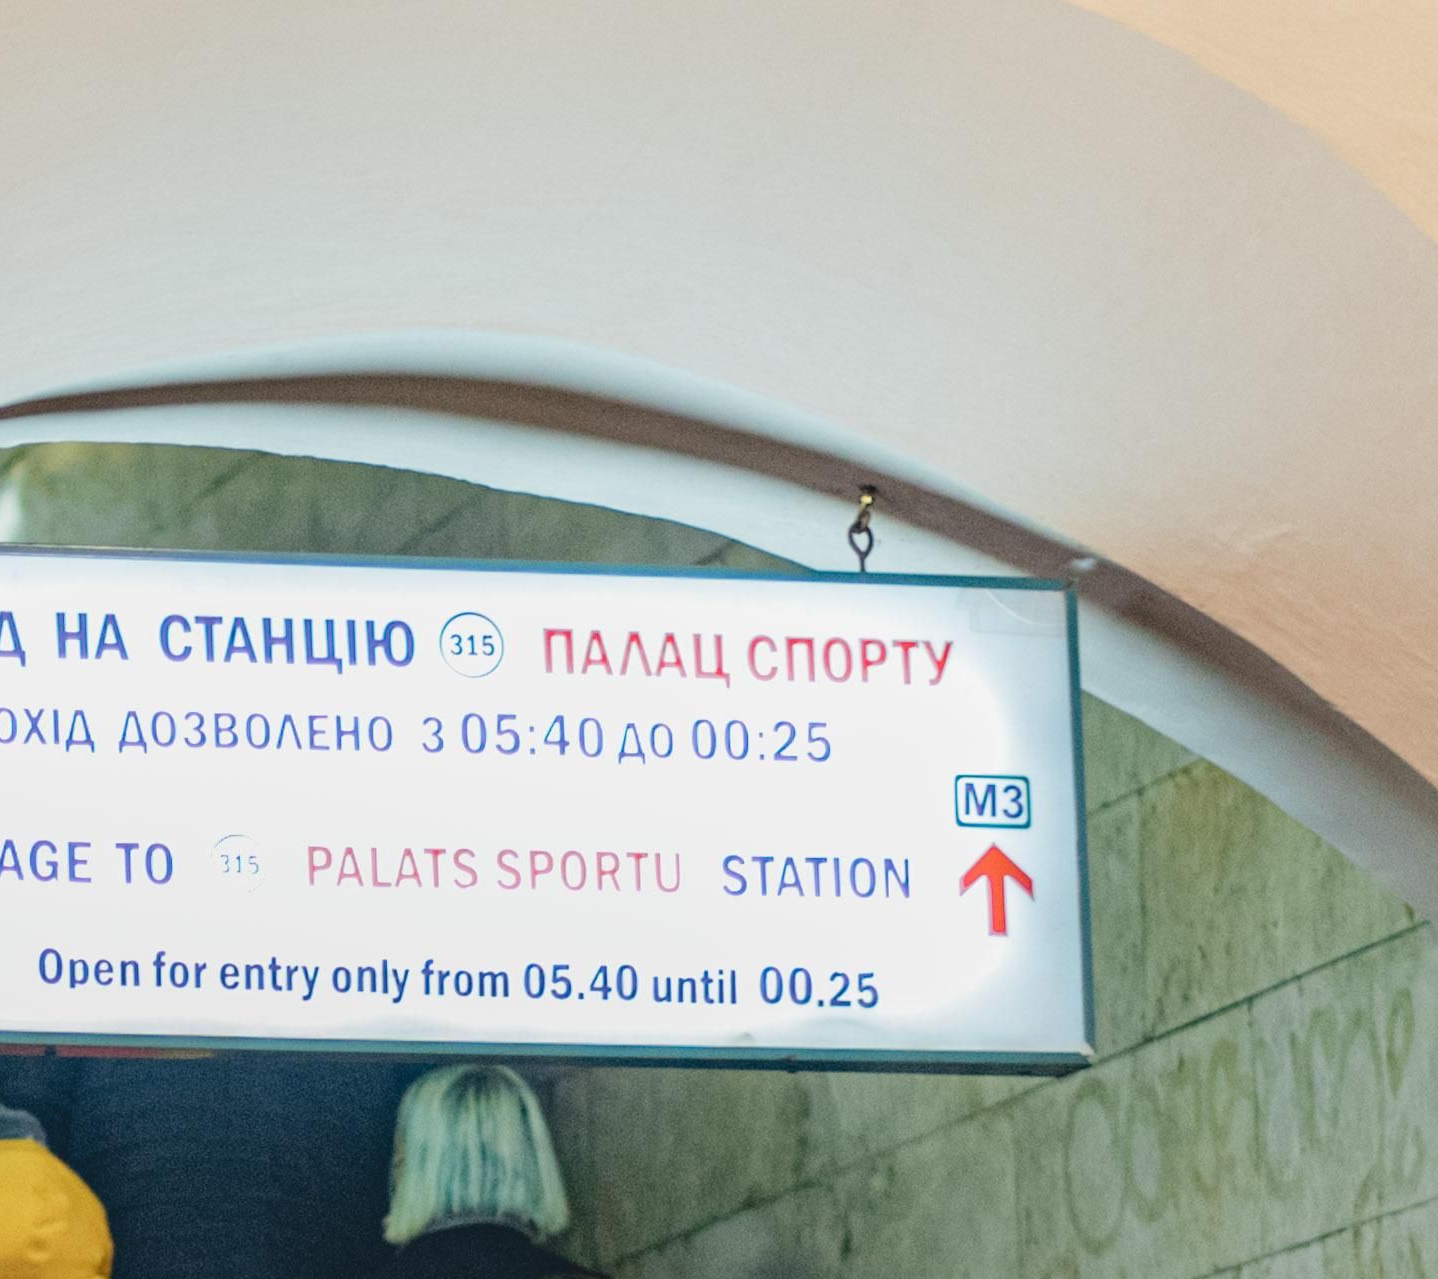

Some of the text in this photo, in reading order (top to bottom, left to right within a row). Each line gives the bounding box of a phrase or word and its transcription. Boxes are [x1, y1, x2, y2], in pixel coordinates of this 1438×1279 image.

[54, 610, 129, 660] НА
[159, 614, 415, 675] СТАНЦІЮ
[450, 634, 494, 656] 315
[543, 628, 730, 688] ПАЛАЦ
[747, 635, 954, 686] СПОРТУ
[118, 711, 393, 754] ДОЗВОЛЕНО
[461, 712, 603, 758] 05:40
[617, 720, 674, 765] ДО
[691, 719, 831, 763] 00:25
[963, 783, 1023, 820] M3
[115, 843, 174, 885] TO
[308, 846, 478, 889] PALATS
[497, 849, 680, 893] SPORTU
[722, 854, 910, 899] STATION
[38, 948, 880, 1010] Open for entry only from 05.40 until 00.25
